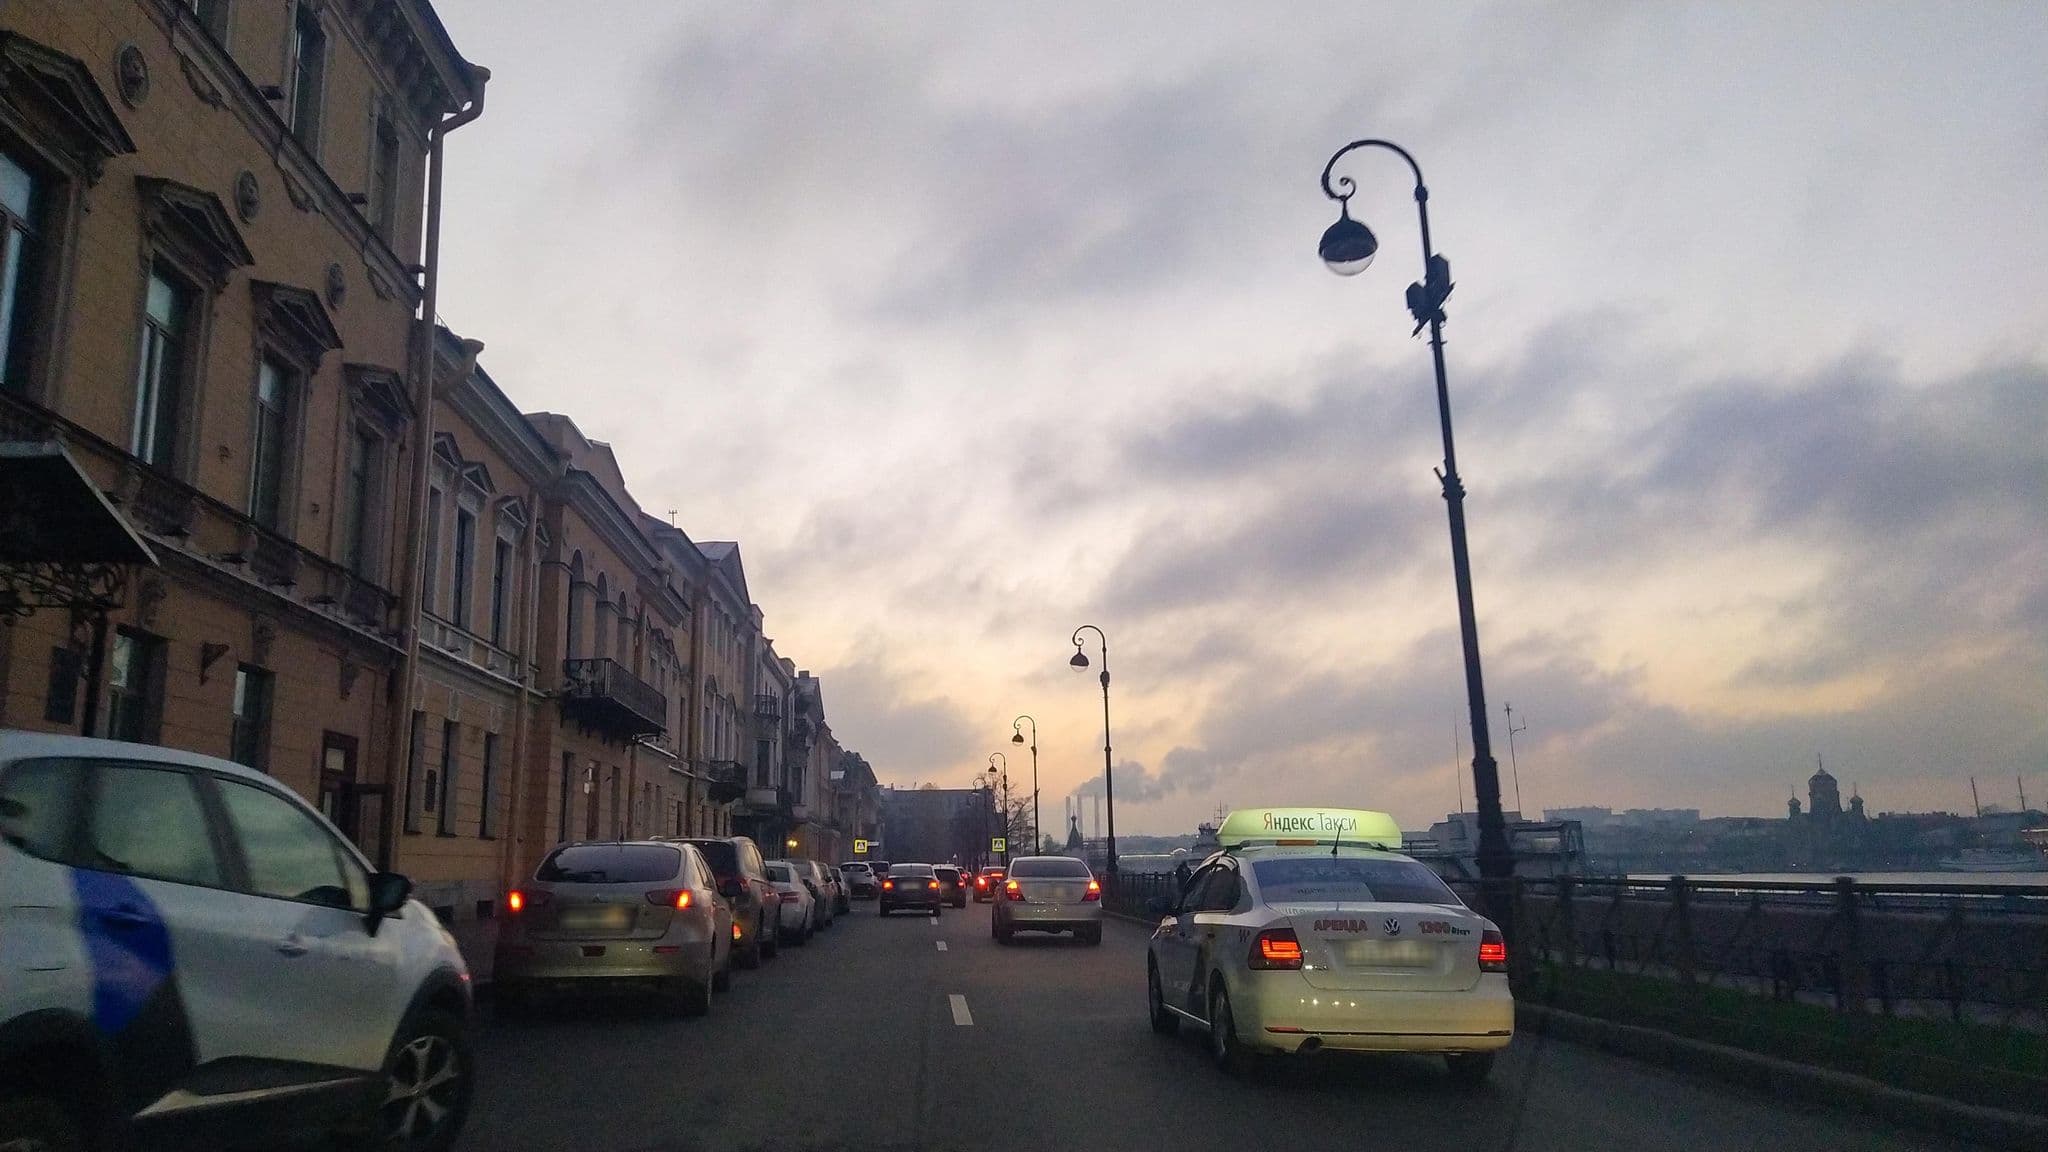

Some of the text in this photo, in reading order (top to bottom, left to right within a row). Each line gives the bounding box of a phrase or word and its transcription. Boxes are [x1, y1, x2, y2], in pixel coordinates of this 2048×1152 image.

[1263, 813, 1357, 832] Яндекс Такси
[1313, 919, 1368, 934] АРЕНДА
